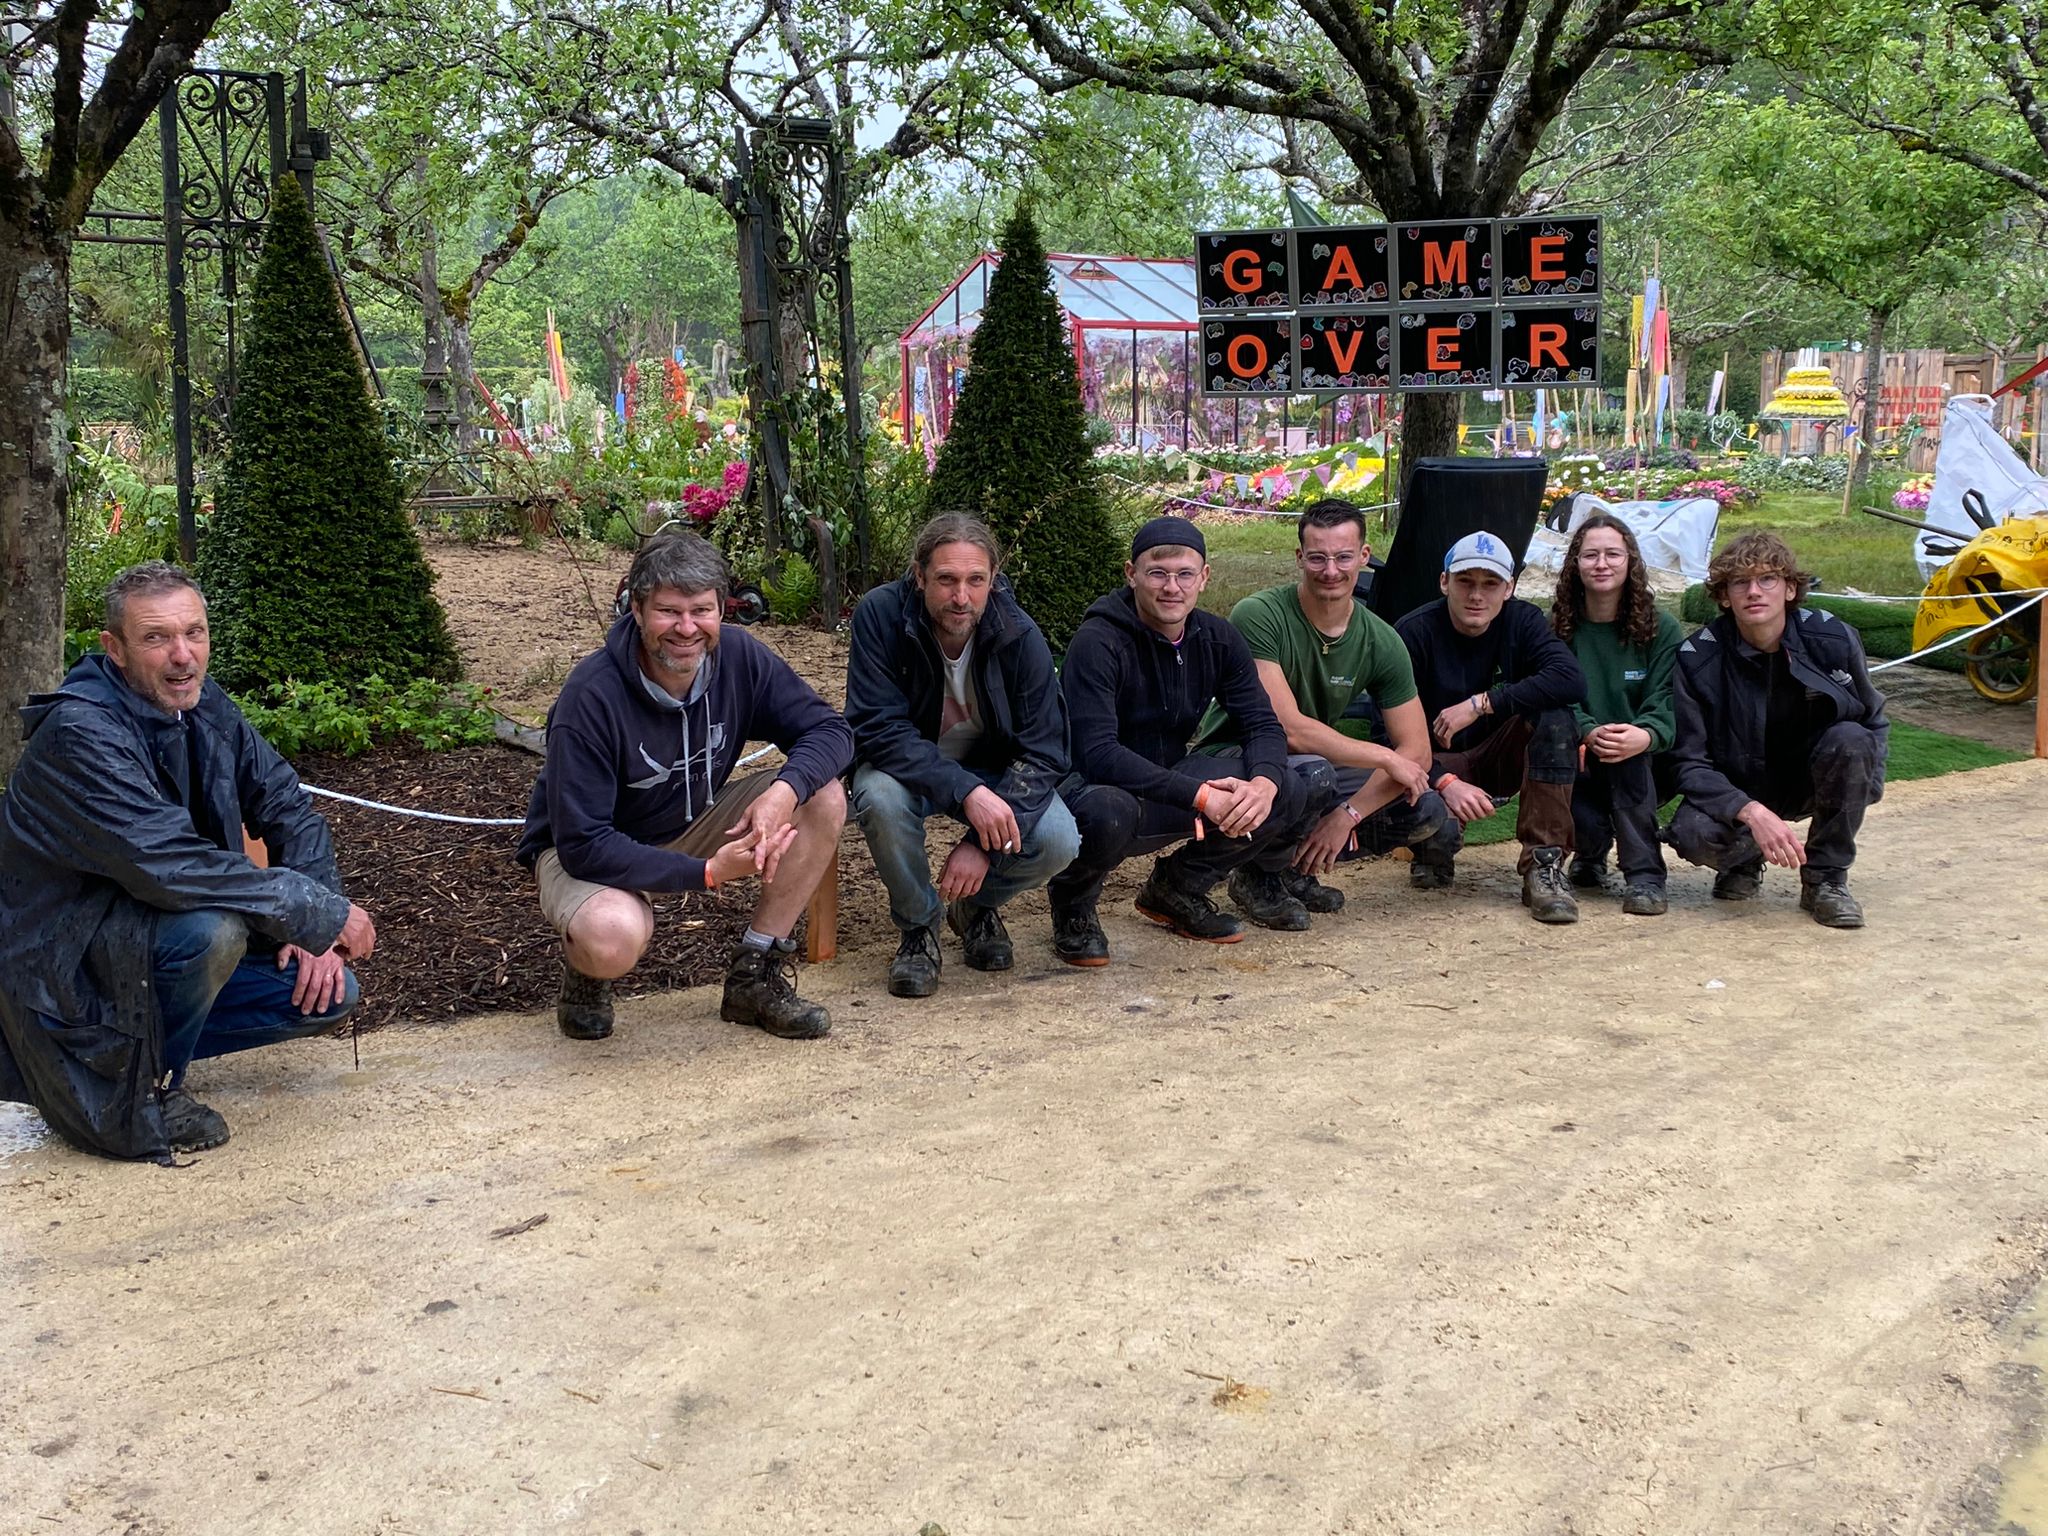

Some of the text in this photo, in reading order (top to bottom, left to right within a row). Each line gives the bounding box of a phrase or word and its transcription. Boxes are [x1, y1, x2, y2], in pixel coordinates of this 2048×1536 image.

[1223, 236, 1566, 293] GAME
[1228, 324, 1569, 377] OVER
[1475, 534, 1495, 556] LA
